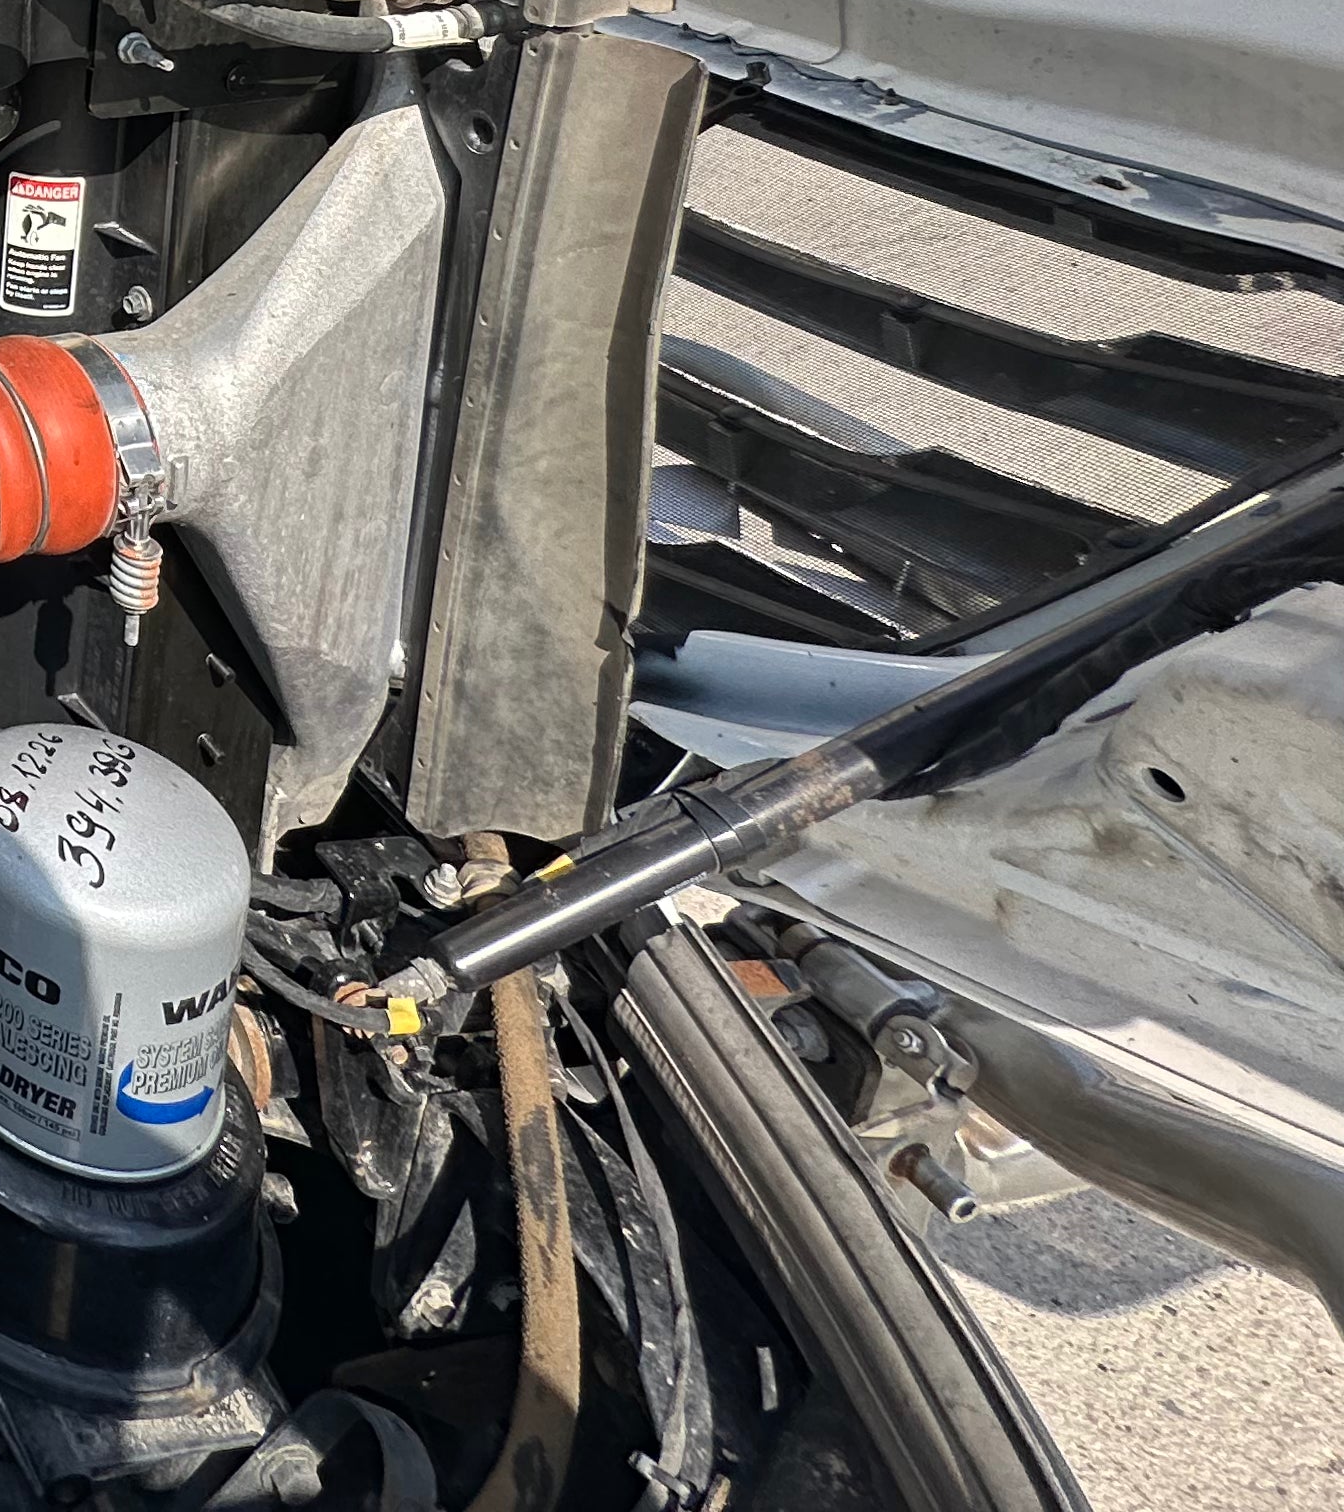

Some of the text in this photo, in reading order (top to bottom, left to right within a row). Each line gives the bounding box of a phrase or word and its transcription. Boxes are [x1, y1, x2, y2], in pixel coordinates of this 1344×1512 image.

[24, 184, 79, 200] DANGER
[50, 254, 66, 262] Fan
[28, 1013, 92, 1062] SERIES
[136, 1032, 204, 1069] SYSTEM
[131, 1054, 209, 1095] PREMIUM
